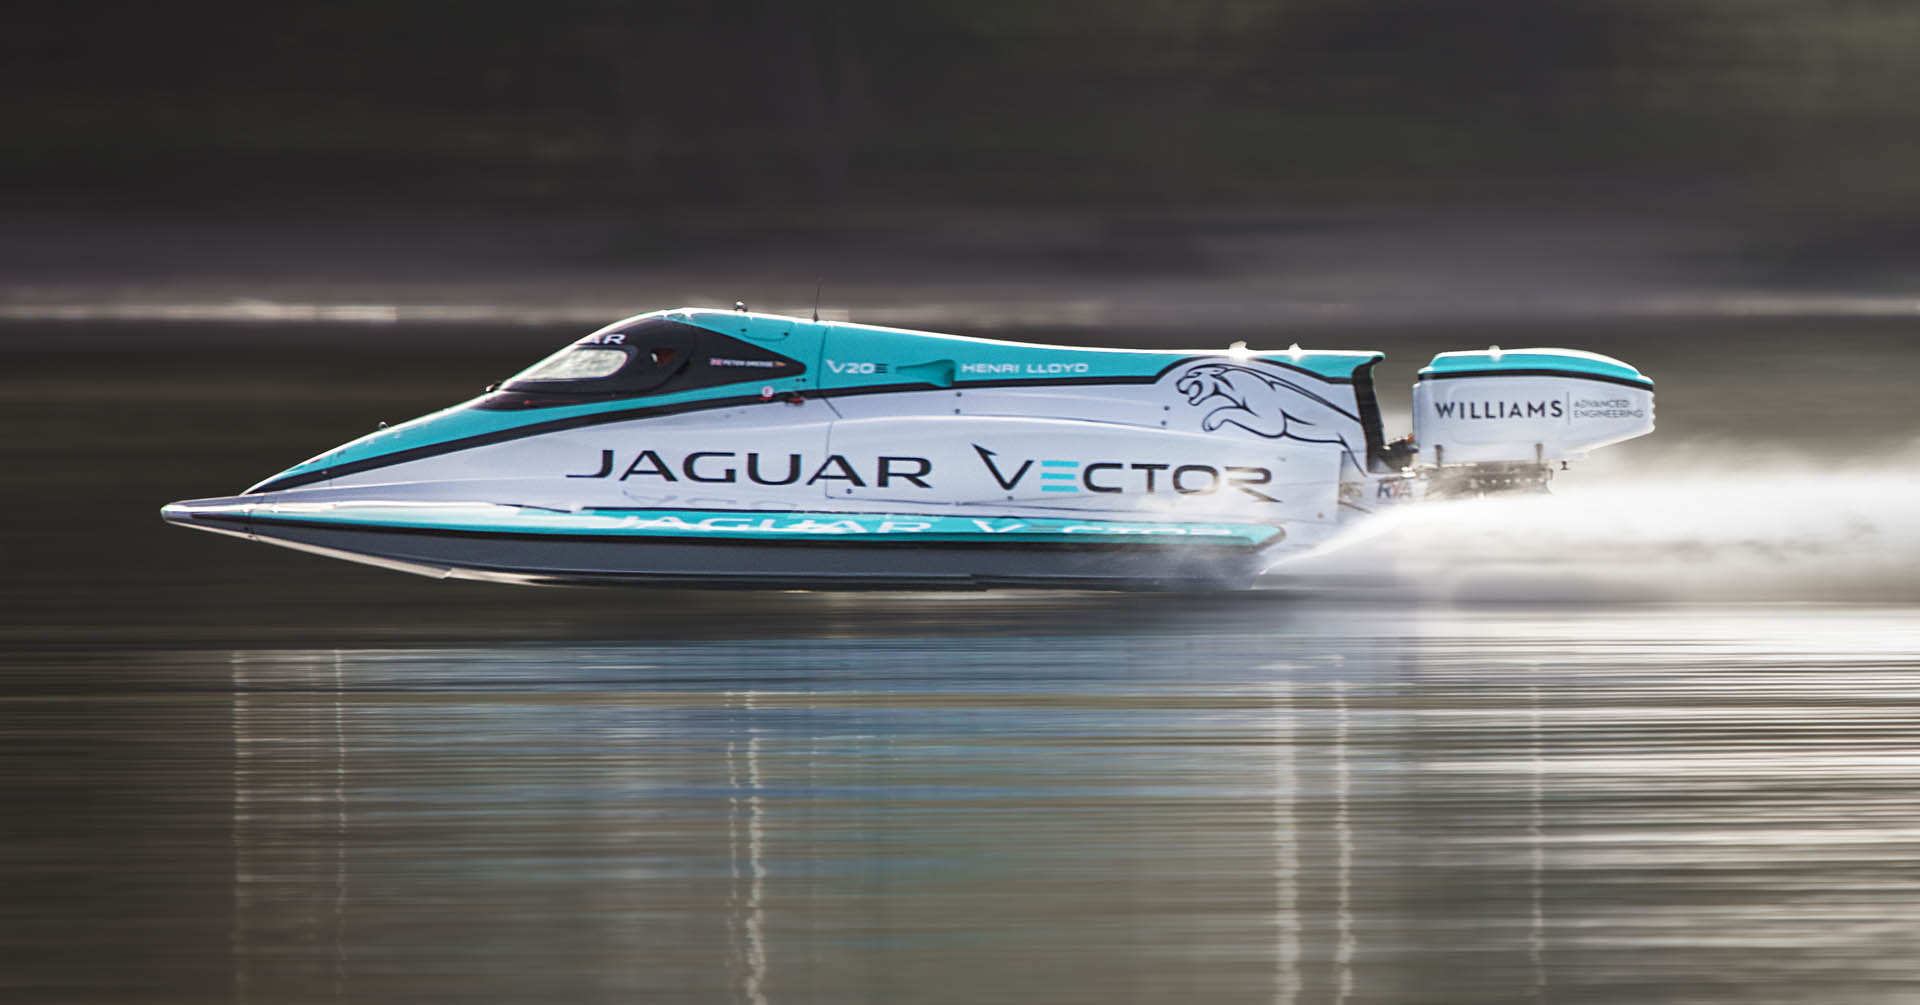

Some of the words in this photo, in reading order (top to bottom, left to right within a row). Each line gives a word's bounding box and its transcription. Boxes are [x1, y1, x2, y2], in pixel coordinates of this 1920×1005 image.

[826, 360, 888, 375] V20E
[961, 363, 1019, 374] HENRI
[1027, 363, 1089, 374] LLOYD
[1434, 400, 1563, 419] WILLIAMS
[1574, 400, 1630, 408] ADVANCED
[1574, 409, 1644, 418] ENGINEERING
[566, 449, 933, 488] JAGUAR
[970, 443, 1282, 503] VECTOR
